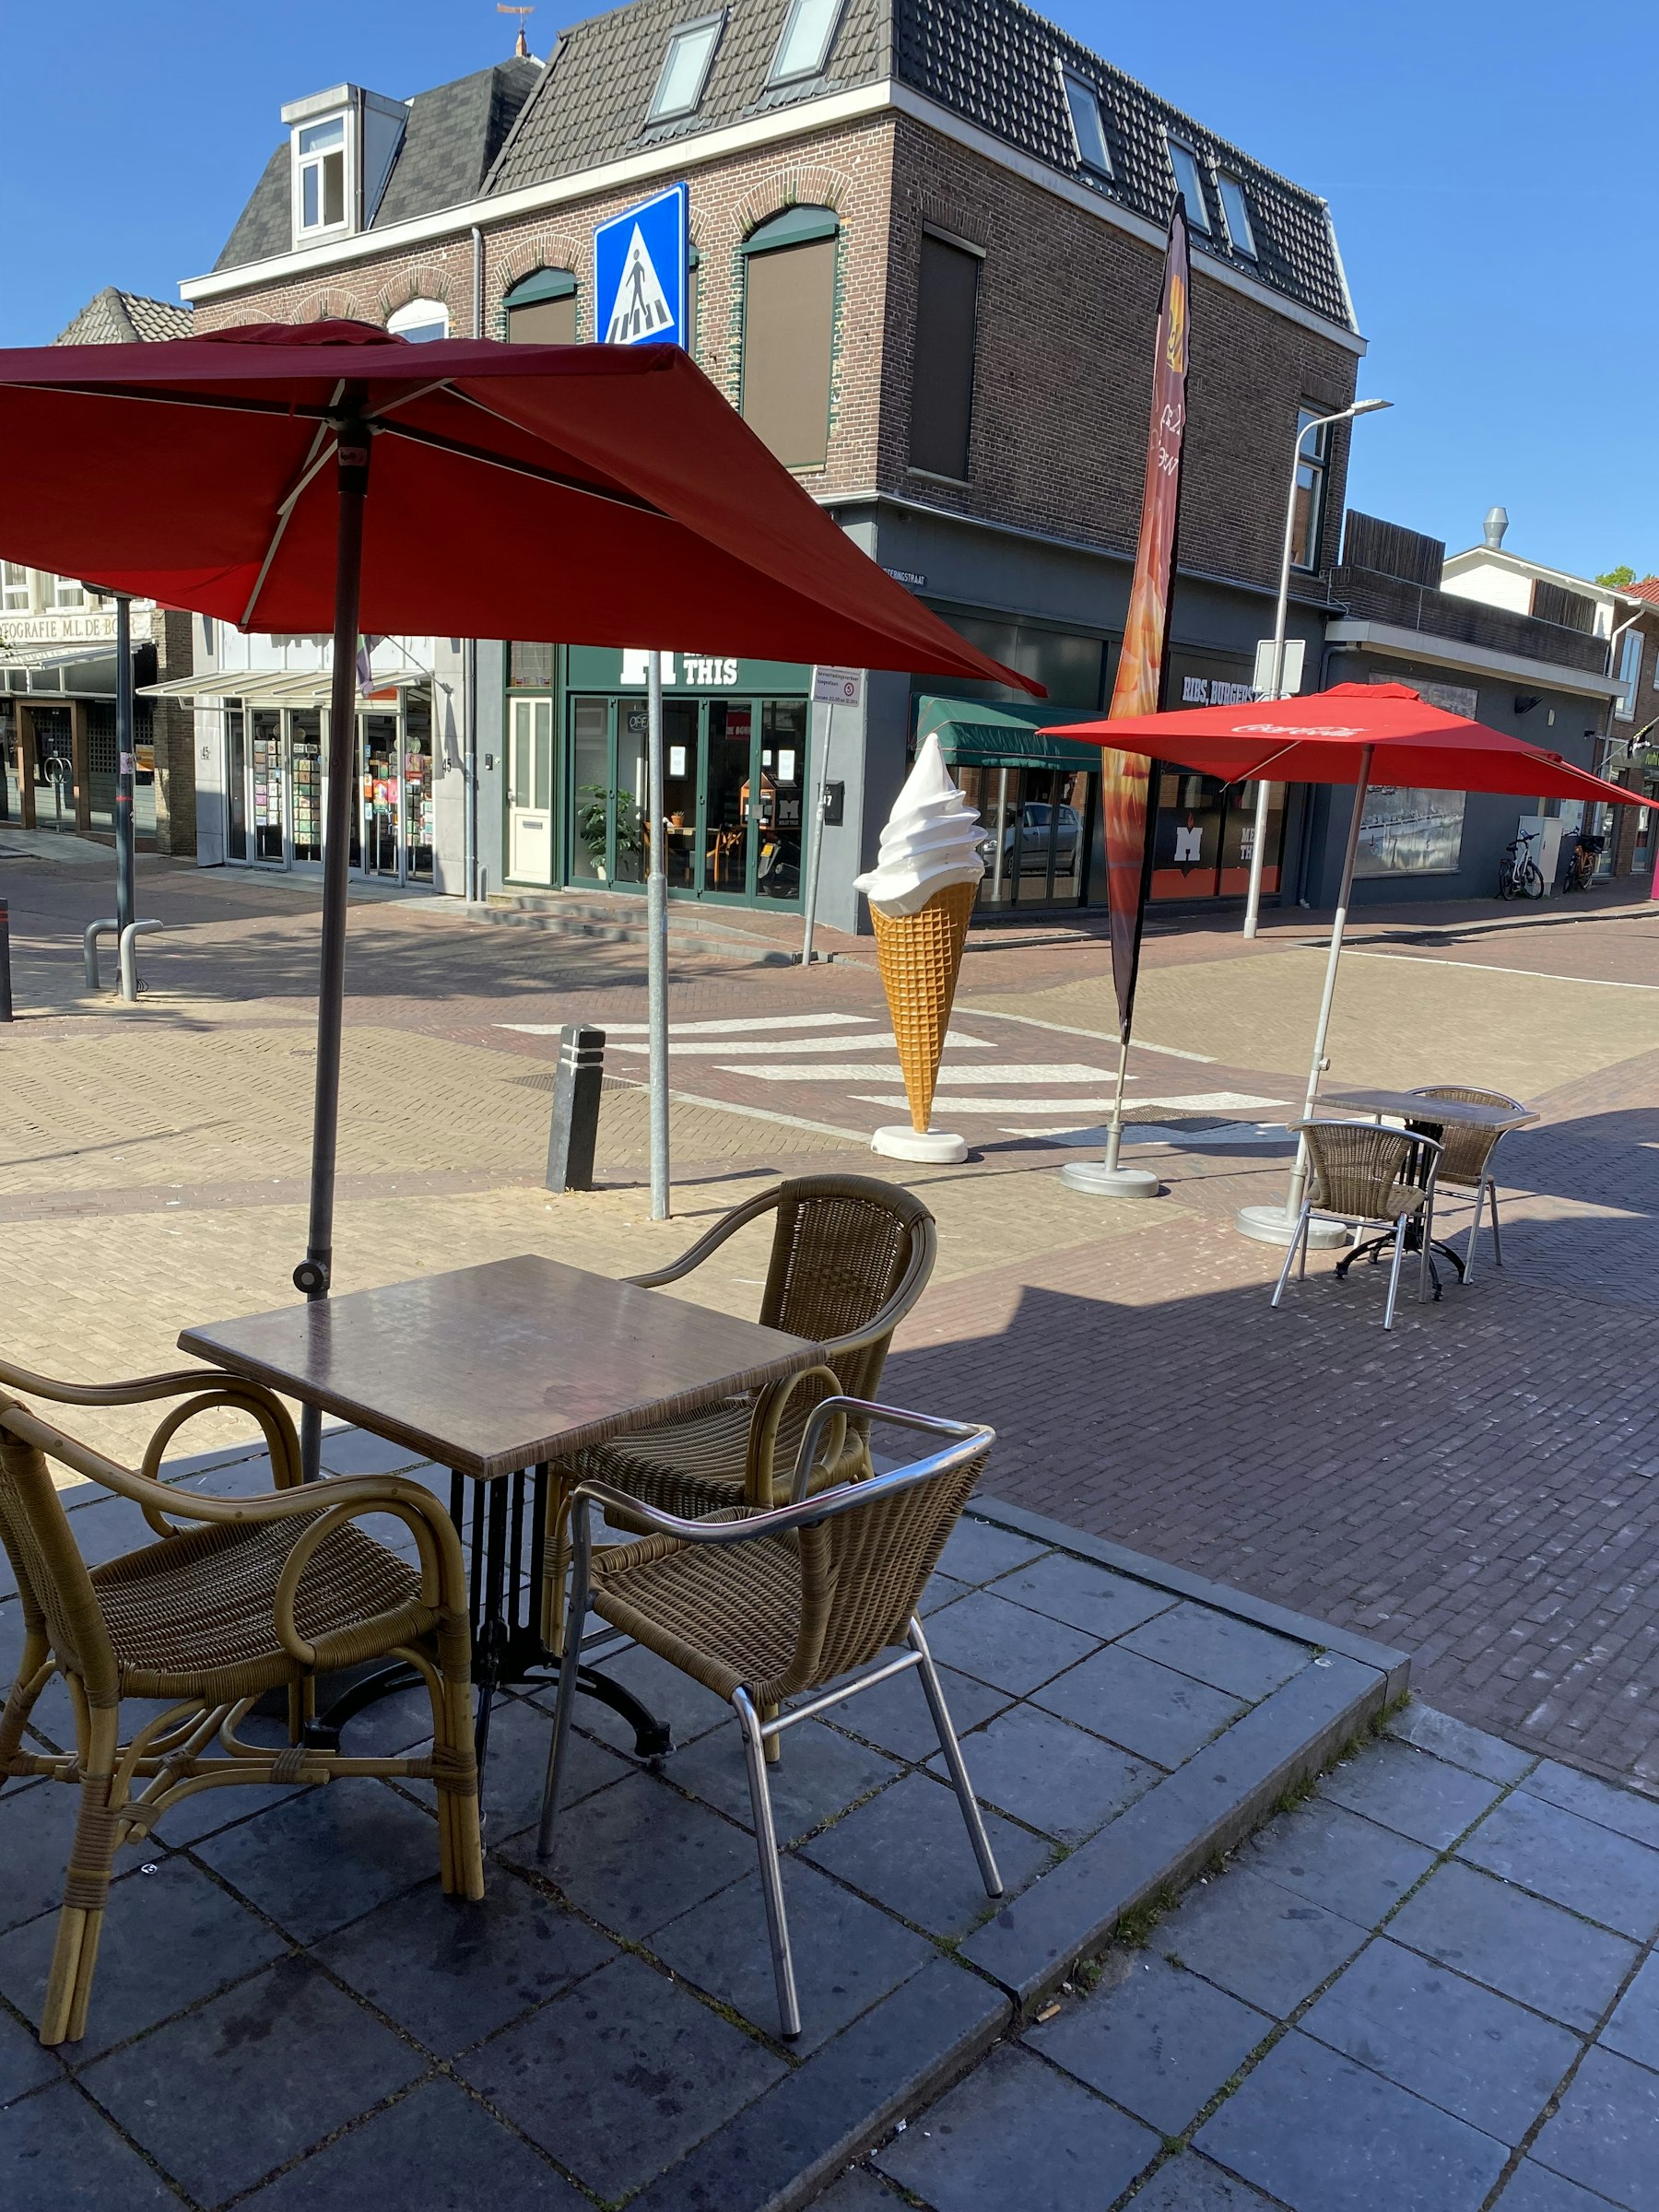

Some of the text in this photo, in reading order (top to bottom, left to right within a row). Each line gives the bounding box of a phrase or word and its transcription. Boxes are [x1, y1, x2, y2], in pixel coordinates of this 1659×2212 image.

[0, 620, 57, 639] TOGRAFIE
[85, 618, 100, 636] DE
[103, 618, 136, 635] BOR
[683, 658, 738, 685] THIS
[1182, 676, 1208, 707] RIBS,
[1209, 679, 1254, 706] BURGERS
[442, 758, 452, 773] 45
